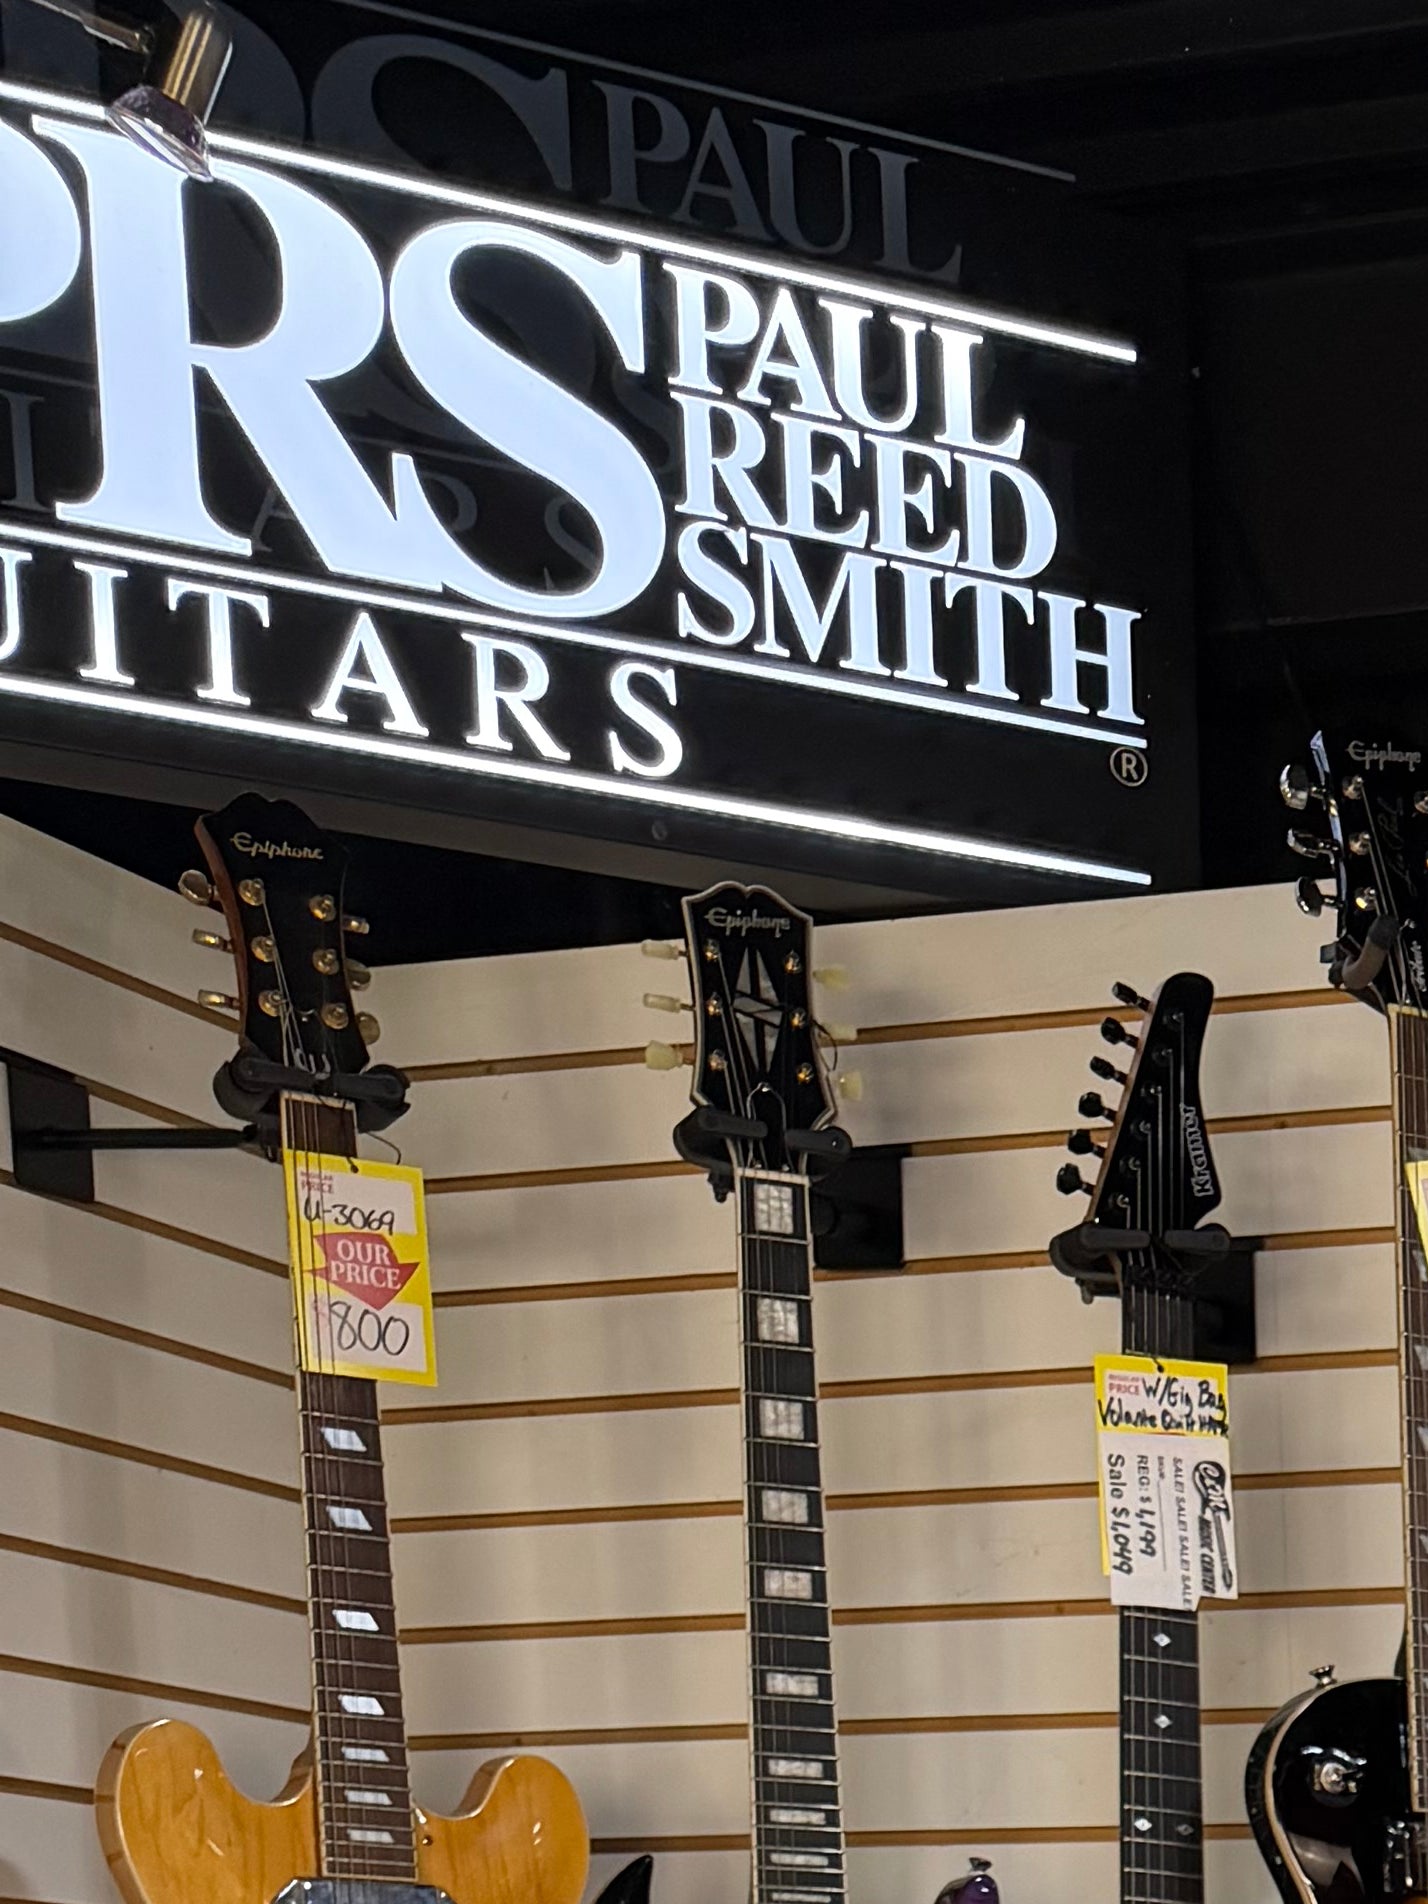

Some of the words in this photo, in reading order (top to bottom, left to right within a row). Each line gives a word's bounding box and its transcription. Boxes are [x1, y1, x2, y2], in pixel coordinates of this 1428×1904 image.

[663, 262, 1024, 459] PAUL
[672, 393, 1059, 580] REED
[676, 517, 1147, 725] SMITH
[0, 550, 685, 778] ITARS
[1346, 740, 1422, 772] Epiphone
[230, 831, 325, 861] Epiphone
[704, 907, 791, 938] Epiphone
[1180, 1102, 1215, 1197] Kramer
[336, 1239, 391, 1266] OUR
[330, 1260, 402, 1290] PRICE
[1108, 1383, 1140, 1396] PRICE
[1107, 1453, 1127, 1499] Sale
[1111, 1506, 1133, 1575] $1,049
[1201, 1553, 1216, 1594] CENTER
